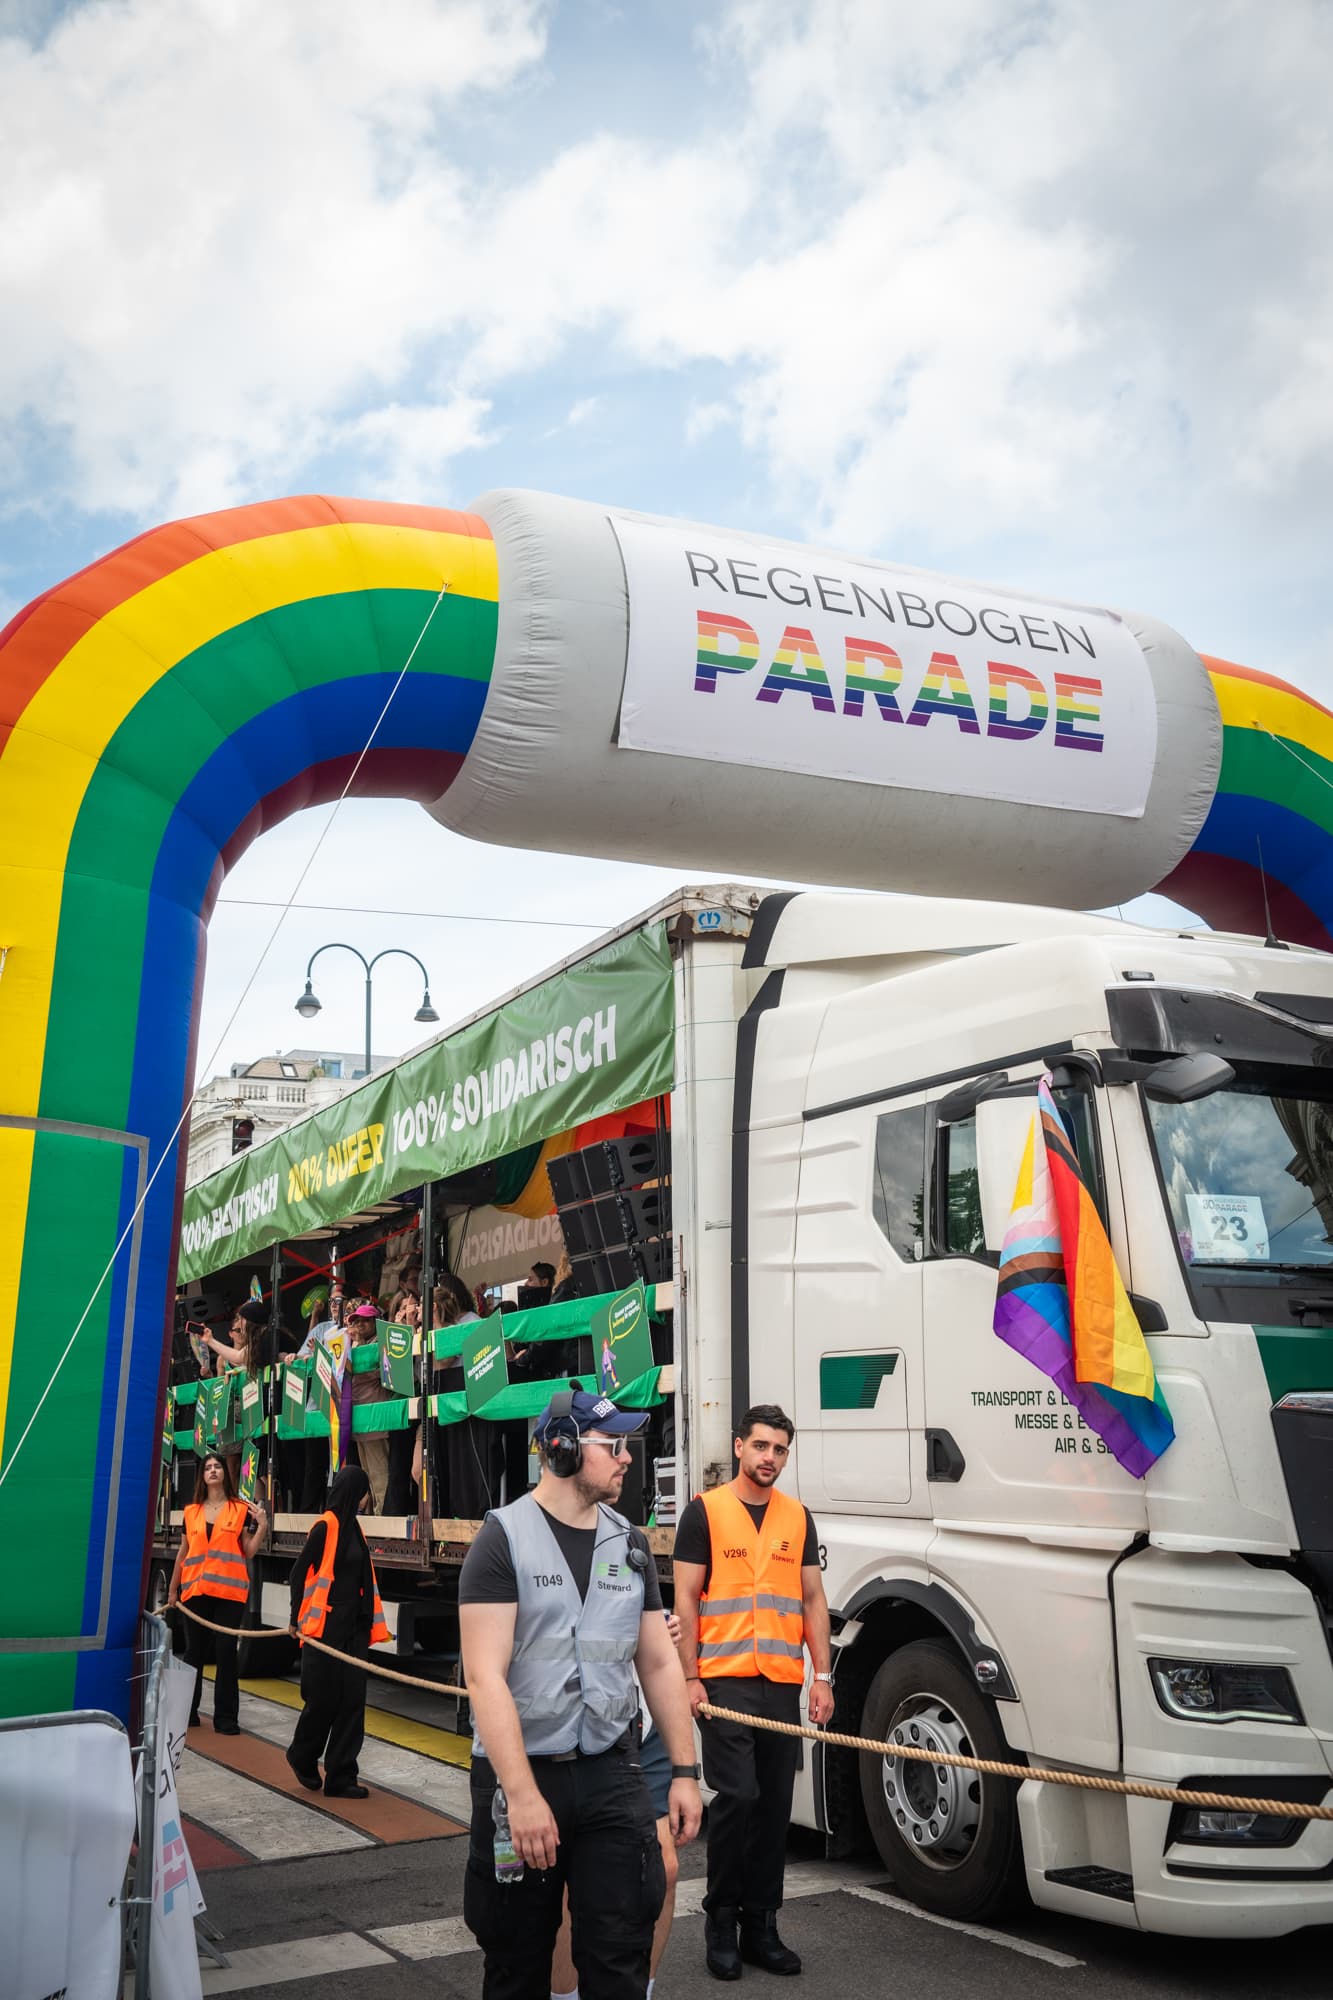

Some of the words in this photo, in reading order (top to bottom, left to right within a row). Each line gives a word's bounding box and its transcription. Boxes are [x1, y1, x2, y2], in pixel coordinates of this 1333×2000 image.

[685, 550, 1097, 659] REGENBOGEN
[694, 609, 1104, 753] PARADE
[288, 1152, 323, 1205] 100%
[326, 1123, 384, 1187] QUEER
[393, 1091, 447, 1156] 100%
[451, 1004, 617, 1132] SOLIDARISCH
[1211, 1215, 1248, 1241] 23
[971, 1391, 1042, 1406] TRANSPORT
[1047, 1390, 1056, 1405] &
[1015, 1414, 1058, 1429] MESSE
[1063, 1414, 1073, 1429] &
[1055, 1438, 1077, 1453] AIR
[1082, 1438, 1092, 1453] &
[723, 1548, 747, 1558] V296
[771, 1553, 795, 1565] Steward
[533, 1574, 563, 1588] T049
[597, 1580, 631, 1592] Steward
